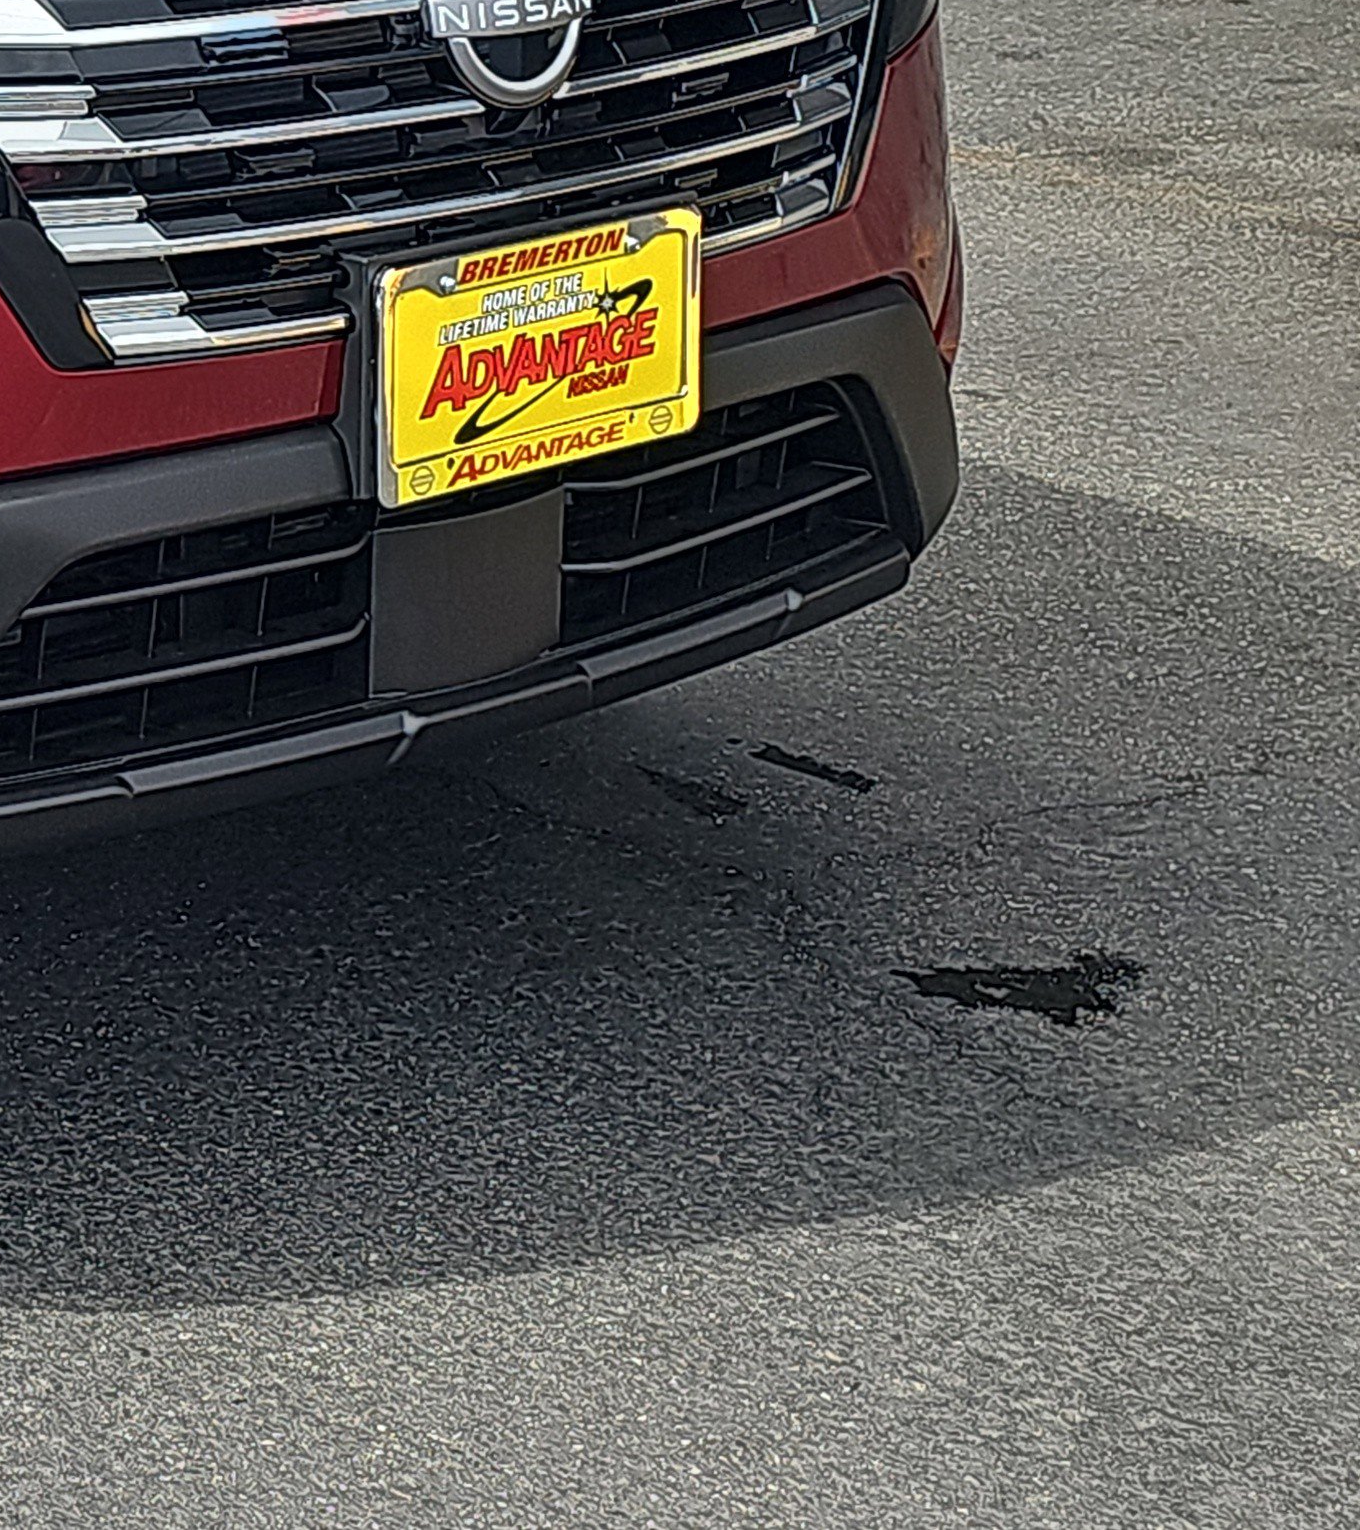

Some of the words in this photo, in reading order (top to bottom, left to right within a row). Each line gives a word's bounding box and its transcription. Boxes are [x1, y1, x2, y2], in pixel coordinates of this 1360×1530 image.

[458, 227, 625, 286] BREMERTON
[438, 311, 510, 346] LIFETIME
[513, 293, 596, 327] WARRANTY
[481, 286, 526, 313] HOME
[531, 279, 551, 303] OF
[554, 273, 583, 295] THE
[420, 308, 659, 420] ADVANTAGE
[567, 365, 630, 399] NISSAN
